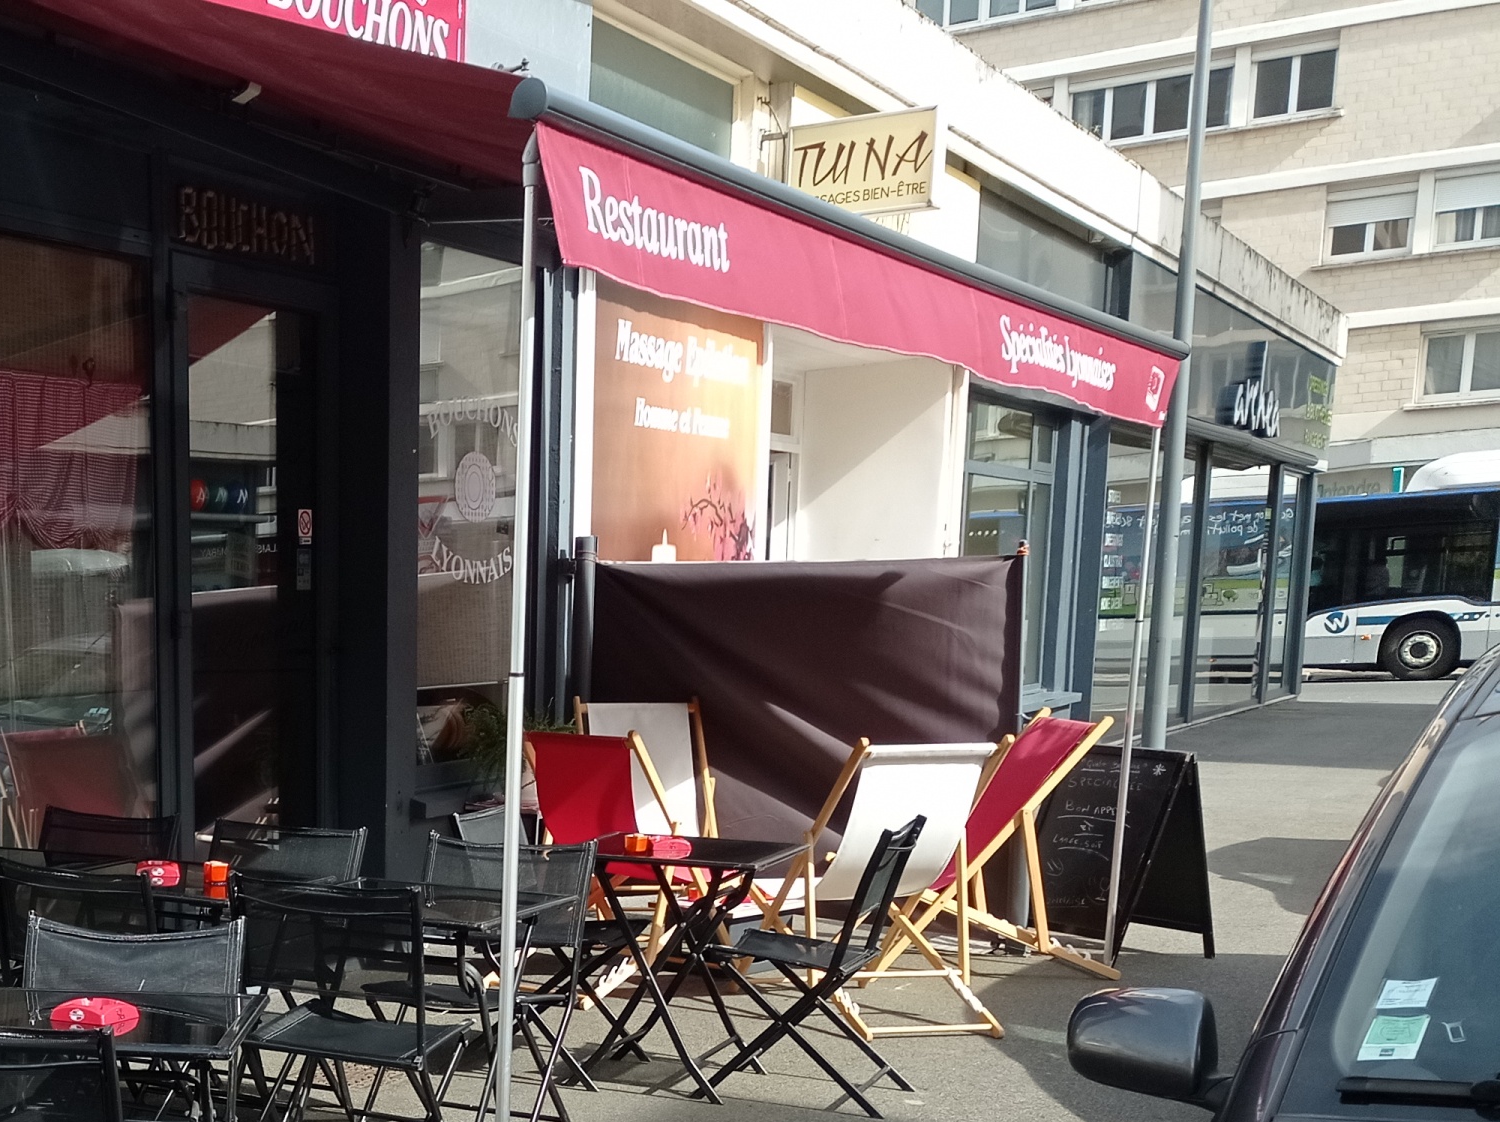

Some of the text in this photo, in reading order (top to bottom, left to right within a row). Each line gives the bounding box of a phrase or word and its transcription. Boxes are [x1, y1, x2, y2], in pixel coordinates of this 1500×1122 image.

[267, 0, 450, 59] UCHONS
[179, 182, 315, 265] BOUCHON
[579, 165, 730, 273] Restaurant
[863, 180, 927, 201] BIEN-ÊTRE
[615, 318, 684, 383] Massage
[1000, 314, 1117, 391] Spécialités Lyonnaises
